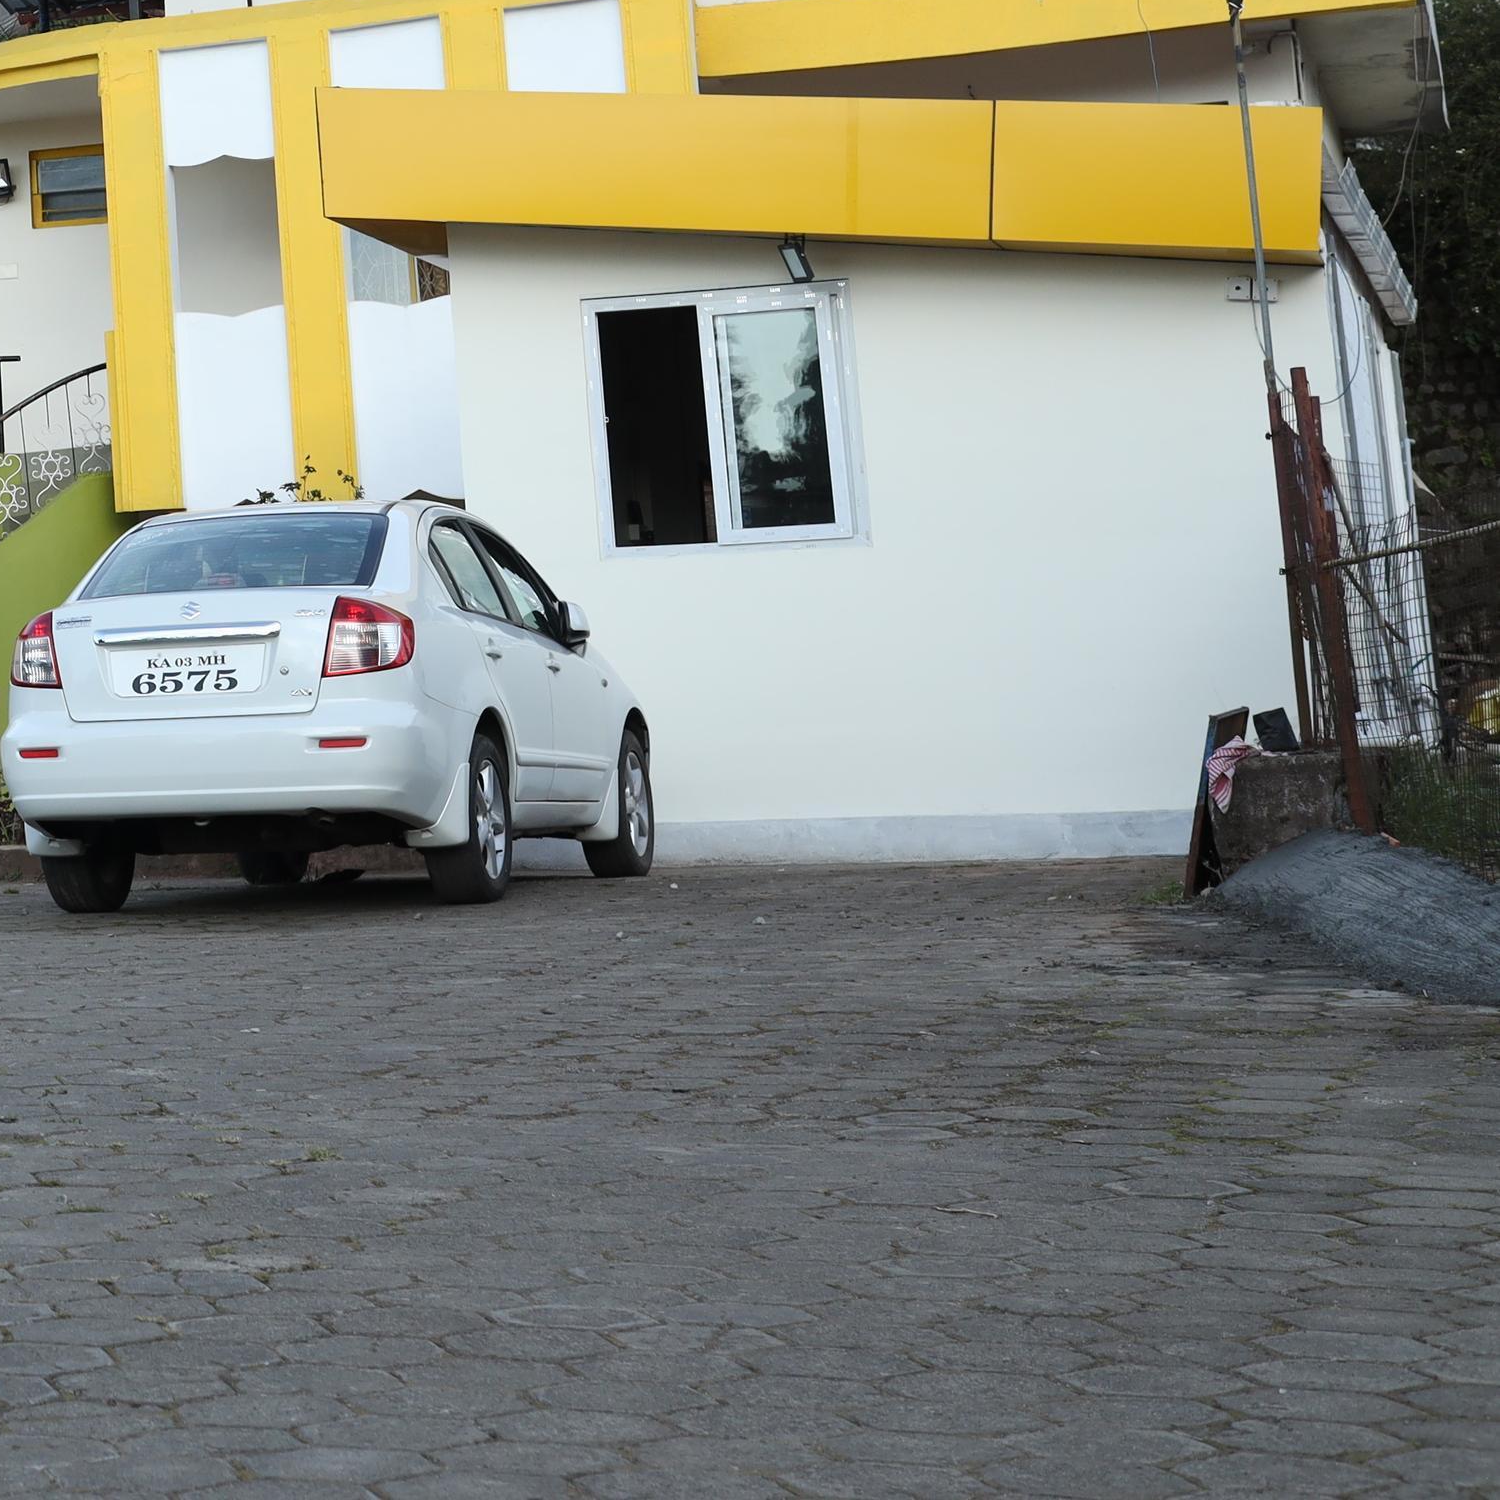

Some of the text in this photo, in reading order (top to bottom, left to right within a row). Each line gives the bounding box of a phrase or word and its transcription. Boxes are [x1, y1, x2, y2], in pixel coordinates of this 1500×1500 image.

[146, 655, 226, 669] KA 03 MH
[131, 669, 239, 695] 6575
